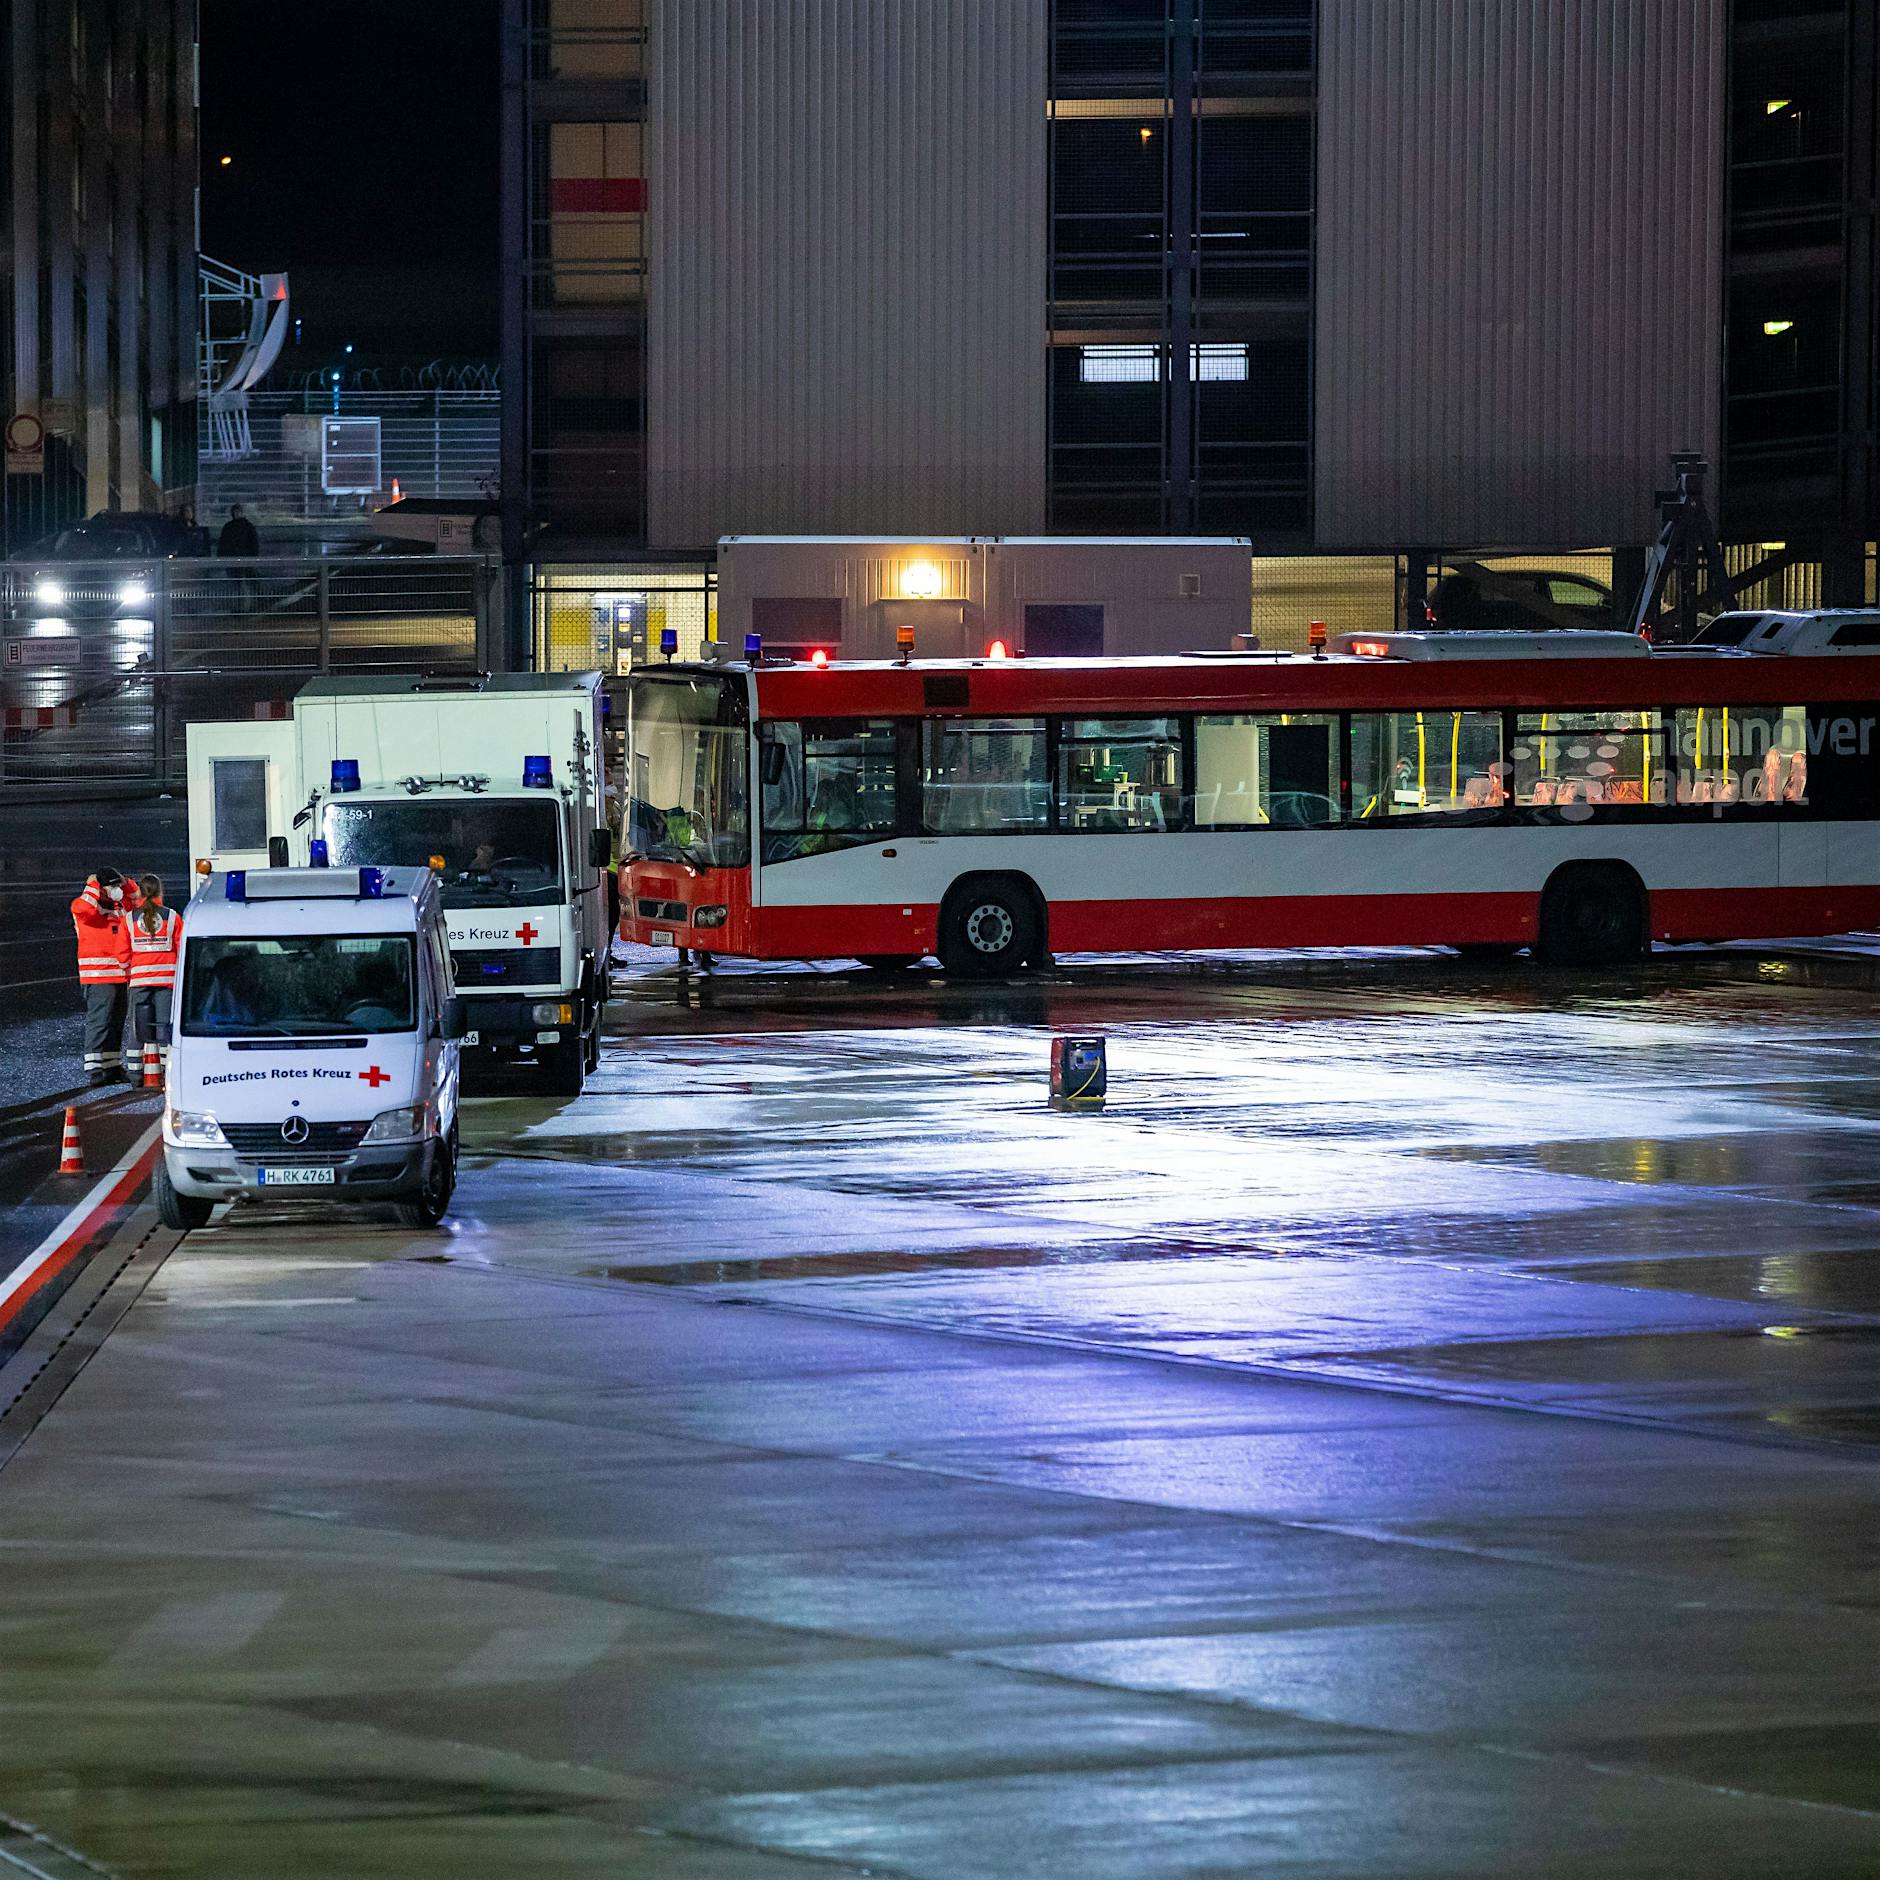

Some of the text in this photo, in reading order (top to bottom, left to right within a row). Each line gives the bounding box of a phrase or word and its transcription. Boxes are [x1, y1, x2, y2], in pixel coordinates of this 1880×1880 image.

[1650, 707, 1876, 756] hannover
[1650, 763, 1810, 818] airport
[469, 928, 510, 940] Kreuz
[202, 1068, 352, 1086] Deutsches Rotes Kreuz
[302, 1170, 332, 1182] 4761
